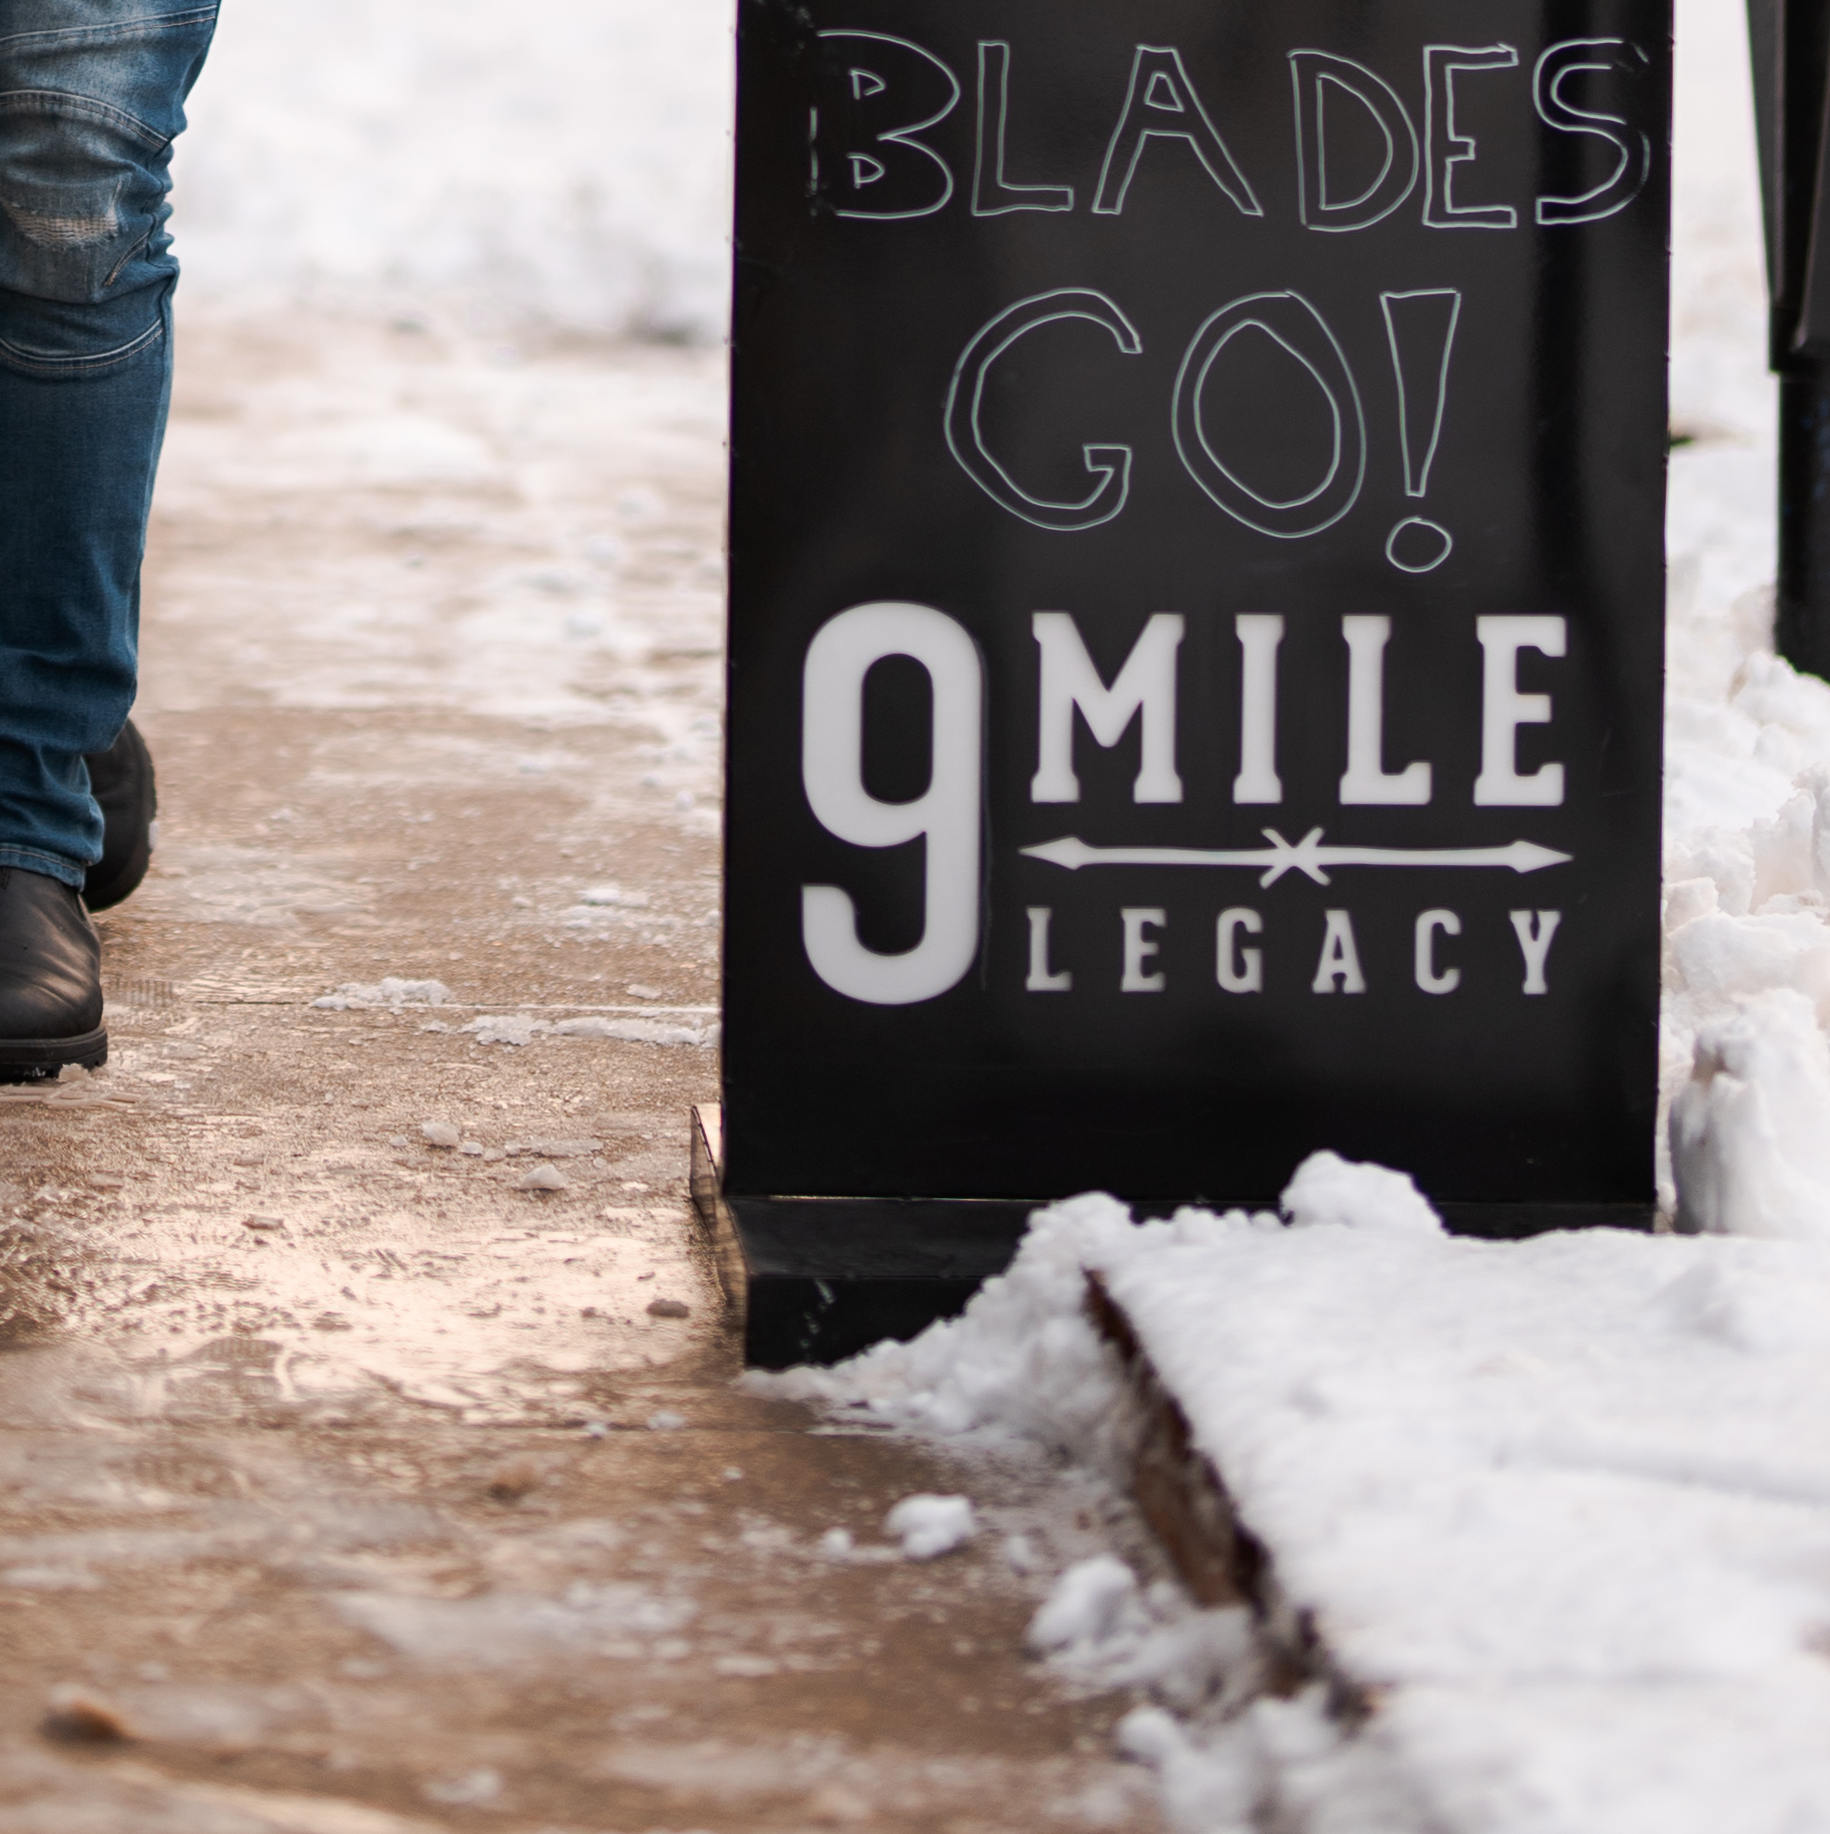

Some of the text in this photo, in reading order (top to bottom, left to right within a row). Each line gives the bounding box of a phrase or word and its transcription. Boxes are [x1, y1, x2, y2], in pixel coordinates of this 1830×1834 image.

[810, 28, 1652, 231] BLADES
[942, 286, 1463, 574] GO!
[800, 599, 1569, 1007] 9 MILE
[1024, 905, 1562, 996] LEGACY
